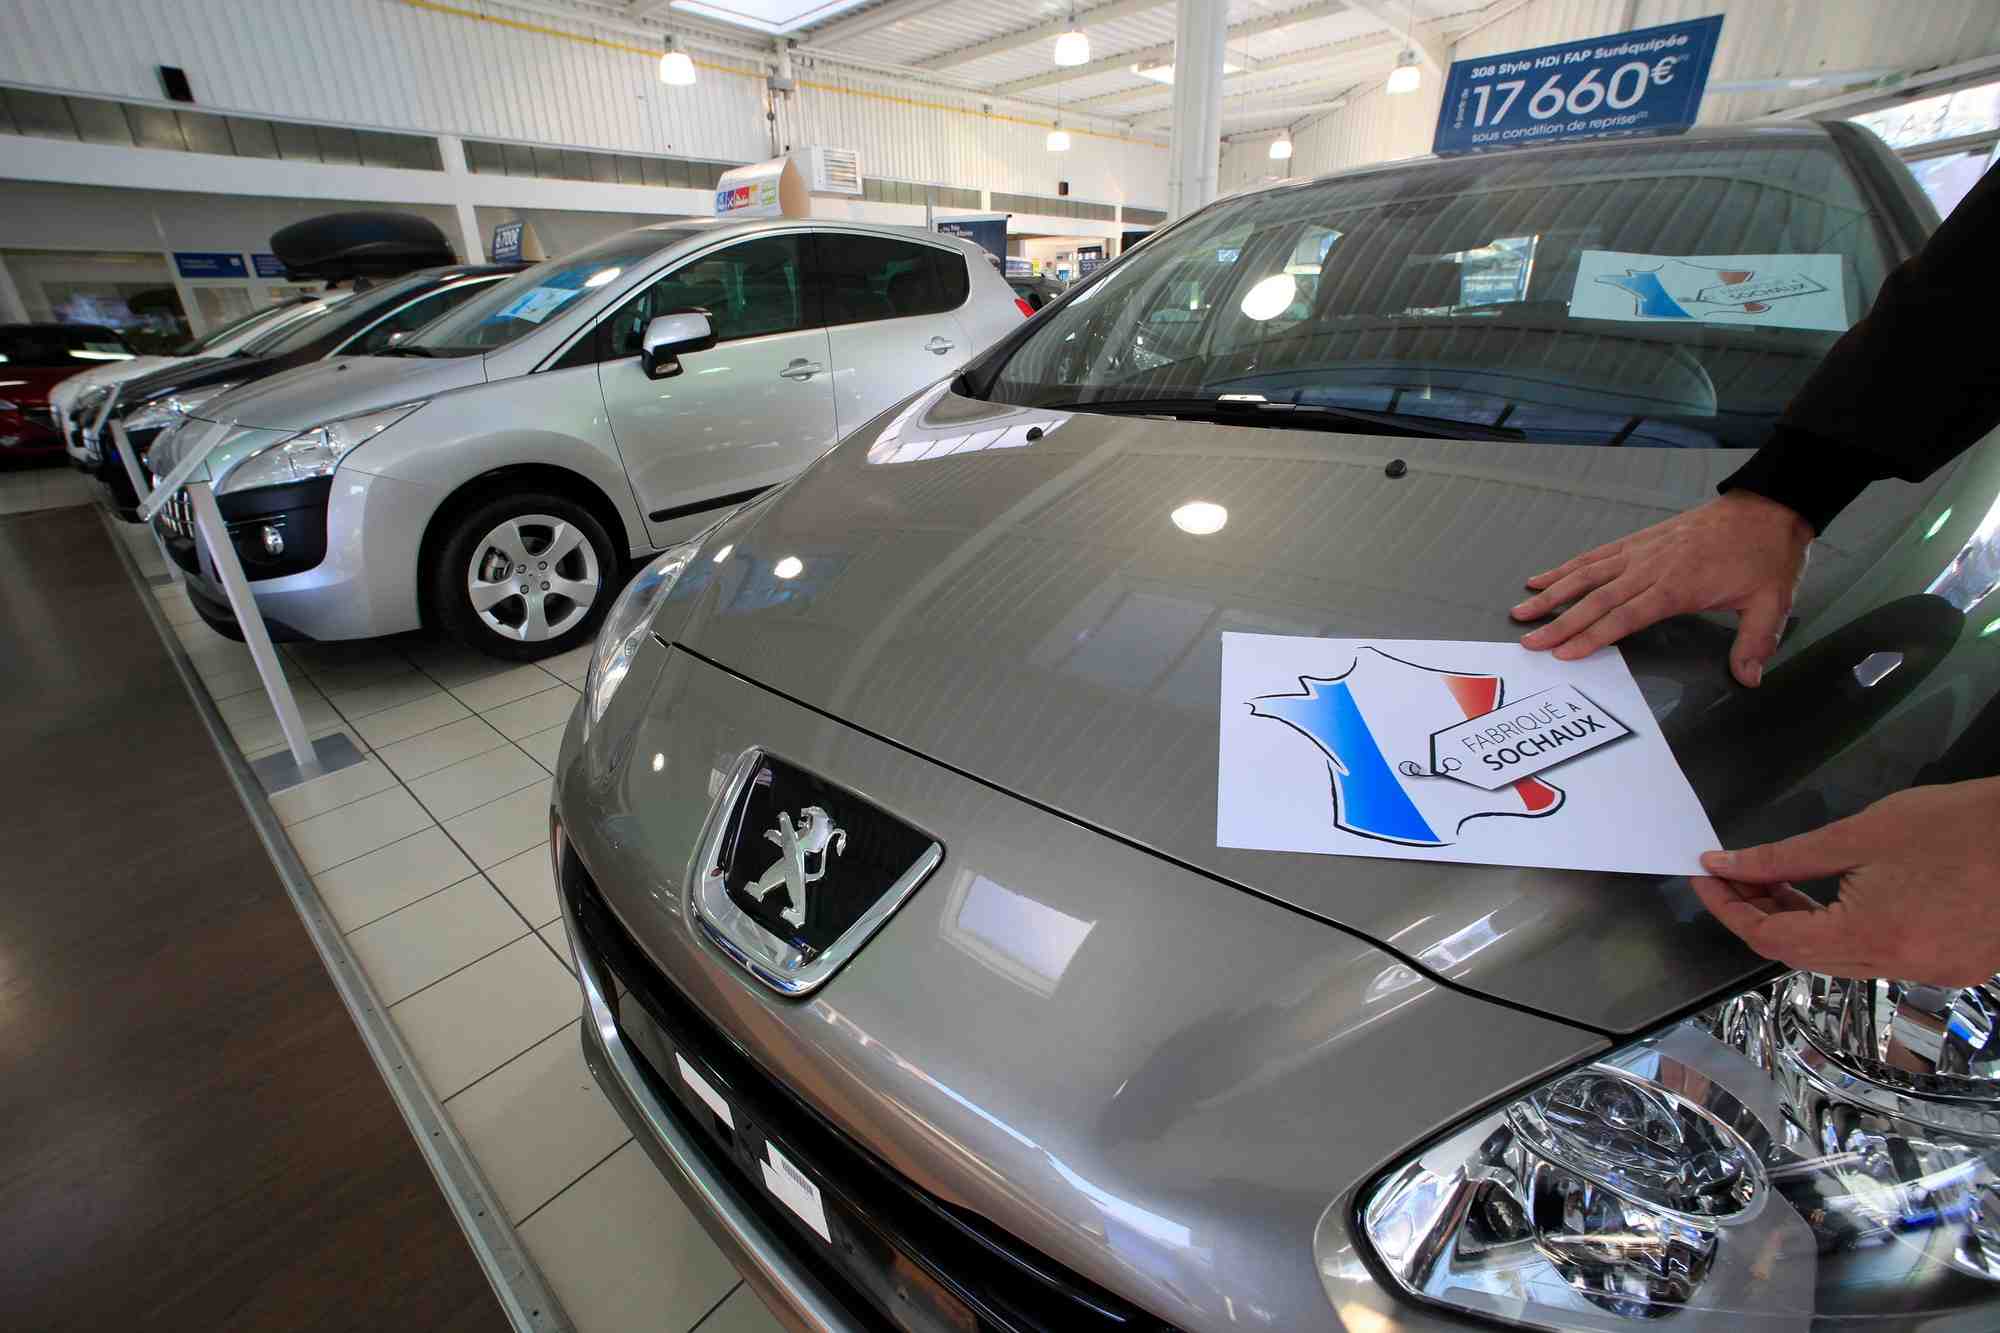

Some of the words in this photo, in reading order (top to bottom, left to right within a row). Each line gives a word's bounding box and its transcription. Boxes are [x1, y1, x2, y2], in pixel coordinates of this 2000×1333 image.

[1471, 65, 1496, 79] 308
[1498, 61, 1532, 76] Style
[1534, 55, 1560, 69] HDi
[1563, 49, 1593, 64] FAP
[1593, 34, 1689, 59] Suréquipée
[1472, 131, 1500, 143] sous
[1502, 121, 1565, 139] condition
[1567, 119, 1587, 131] de
[1462, 701, 1567, 753] FABRIQUÉ
[1482, 714, 1606, 771] SOCHAUX
